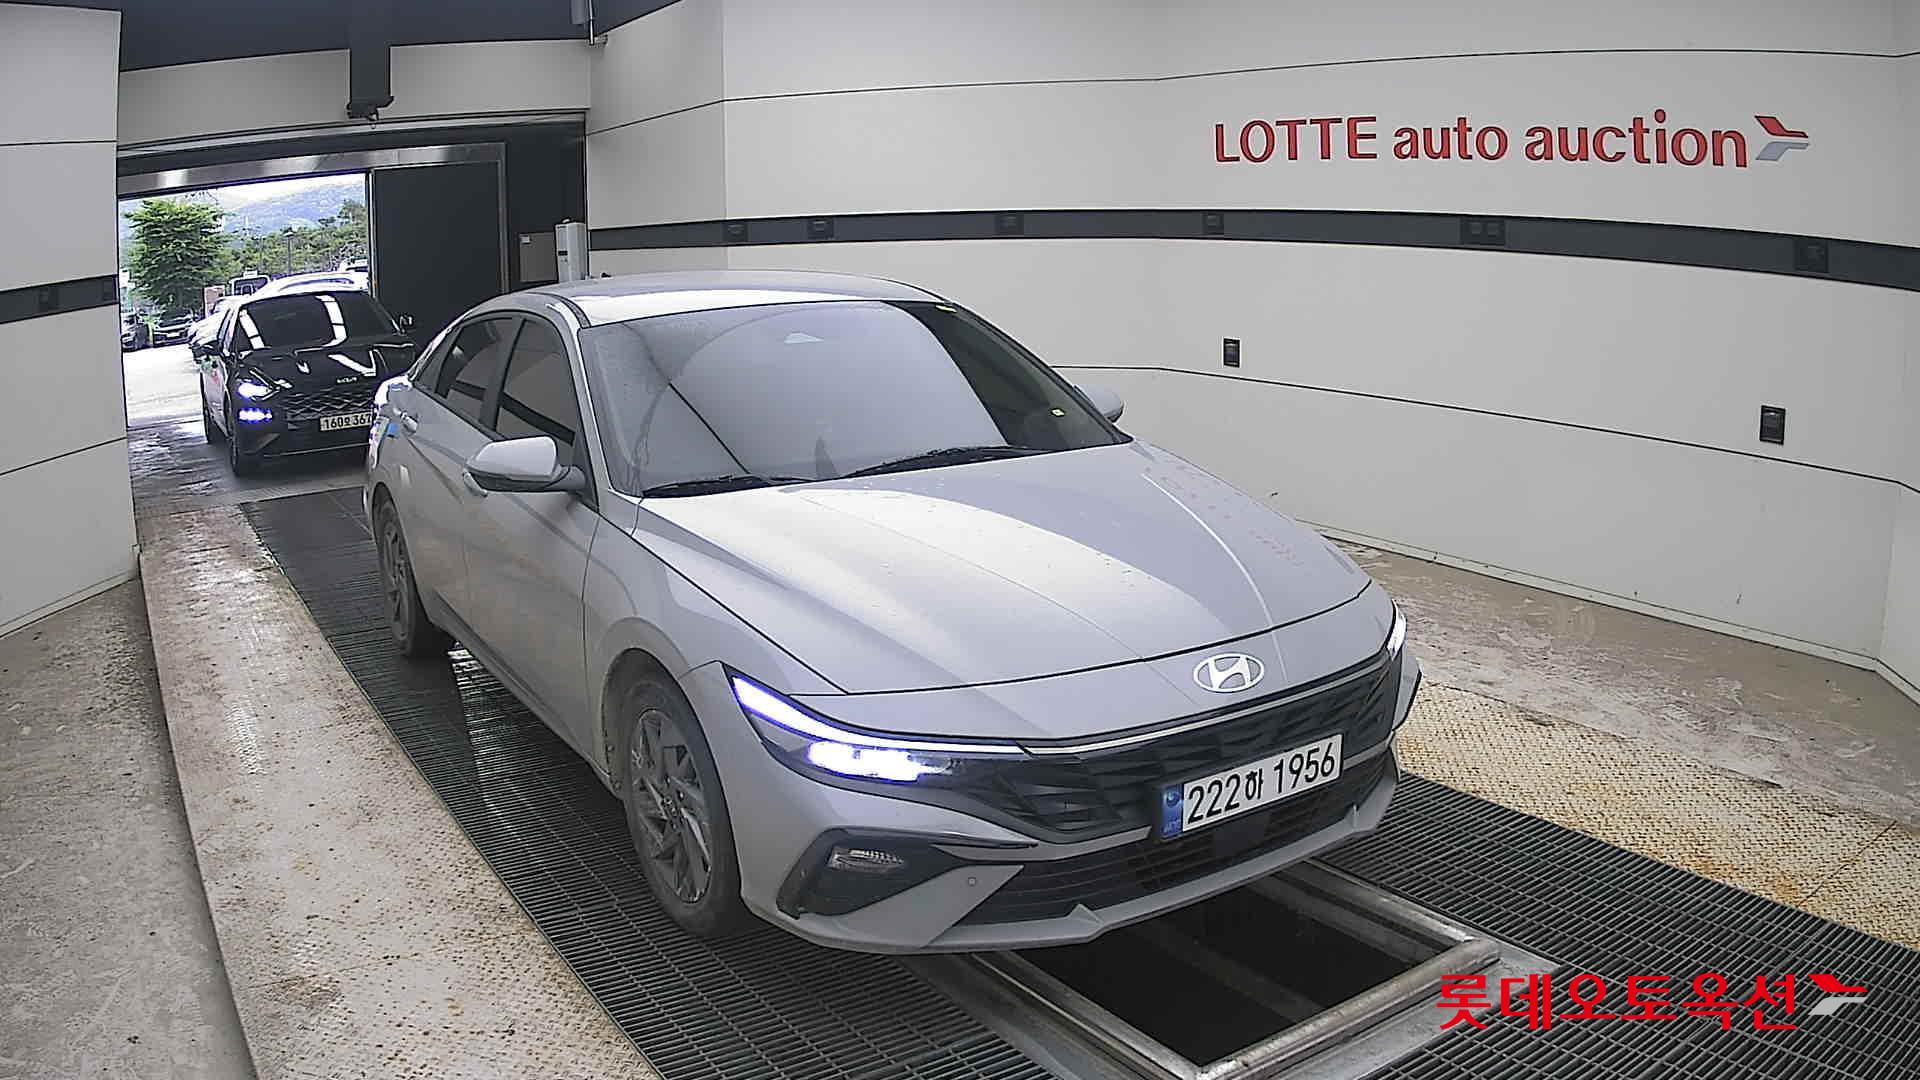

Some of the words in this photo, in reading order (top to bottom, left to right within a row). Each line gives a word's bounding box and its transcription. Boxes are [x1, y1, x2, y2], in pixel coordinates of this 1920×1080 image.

[1214, 116, 1377, 162] LOTTE
[1393, 117, 1510, 160] auto
[1524, 109, 1748, 168] auction
[353, 413, 372, 426] 367
[1187, 768, 1264, 825] 222하
[1273, 743, 1336, 794] 1956
